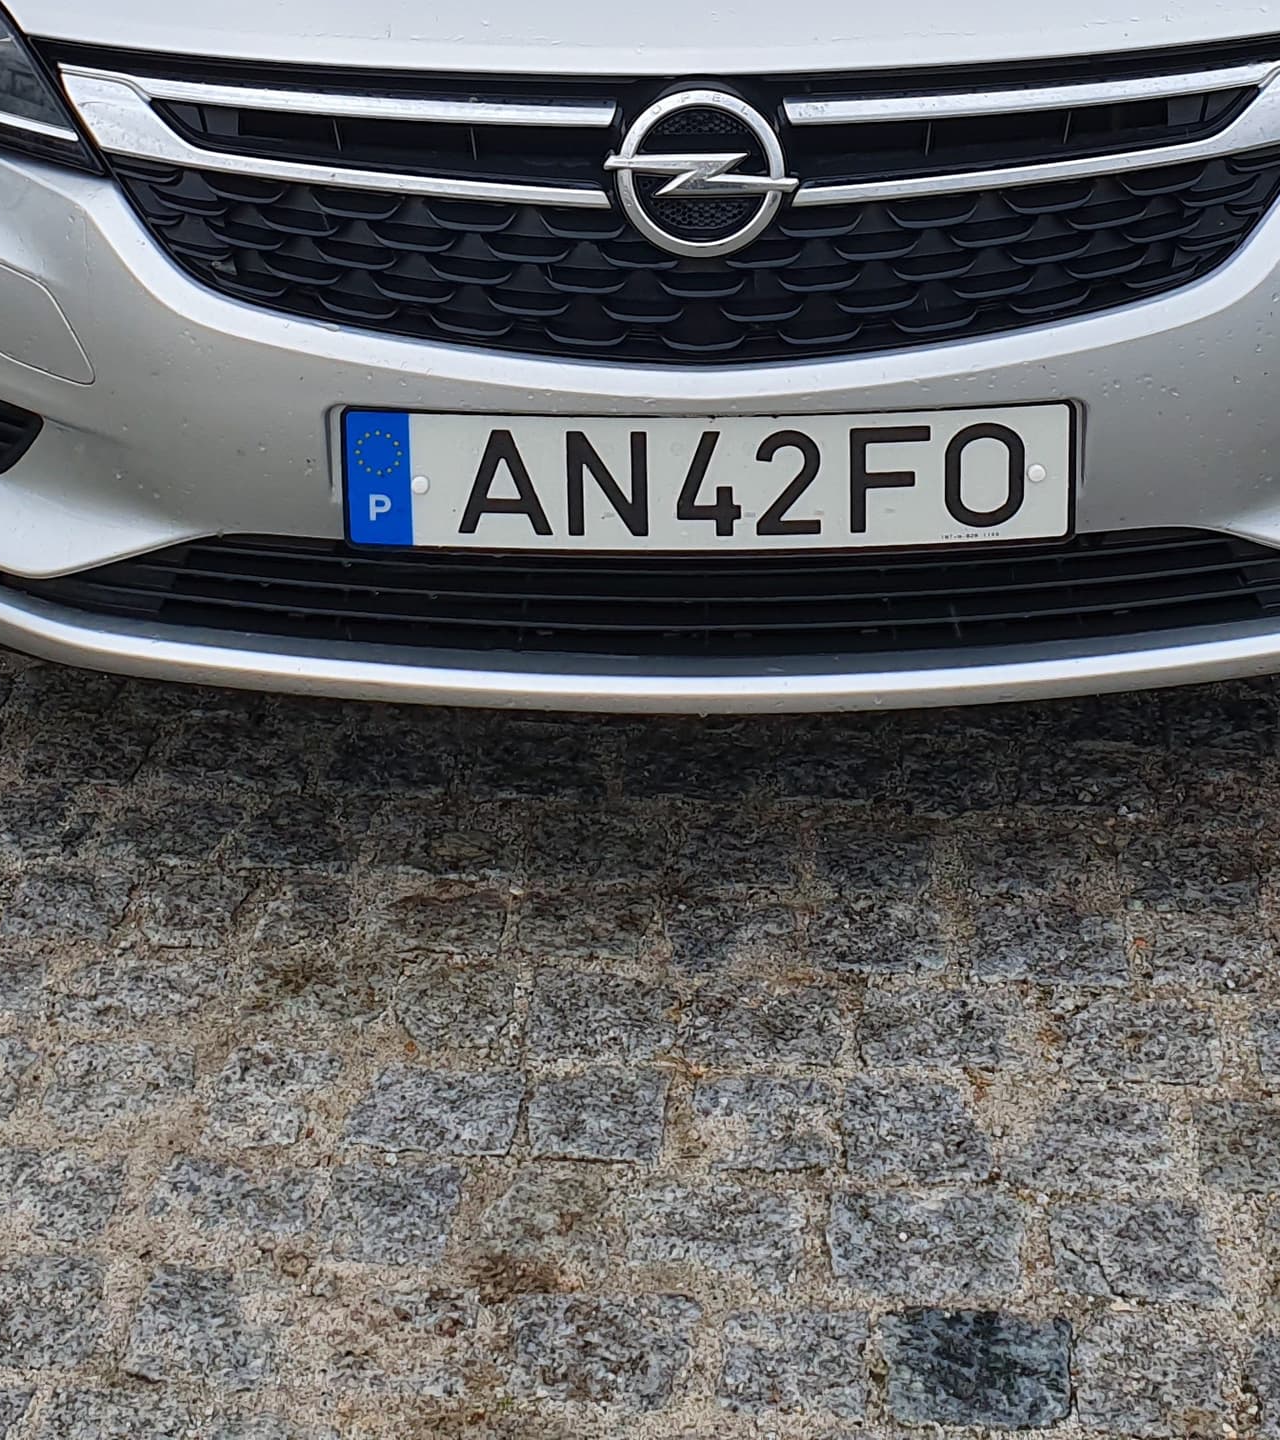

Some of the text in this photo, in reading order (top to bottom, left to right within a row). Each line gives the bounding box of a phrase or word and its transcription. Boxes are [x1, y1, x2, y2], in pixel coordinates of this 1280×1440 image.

[650, 93, 750, 117] OPEL
[457, 422, 1026, 537] AN42FO
[369, 493, 393, 522] P
